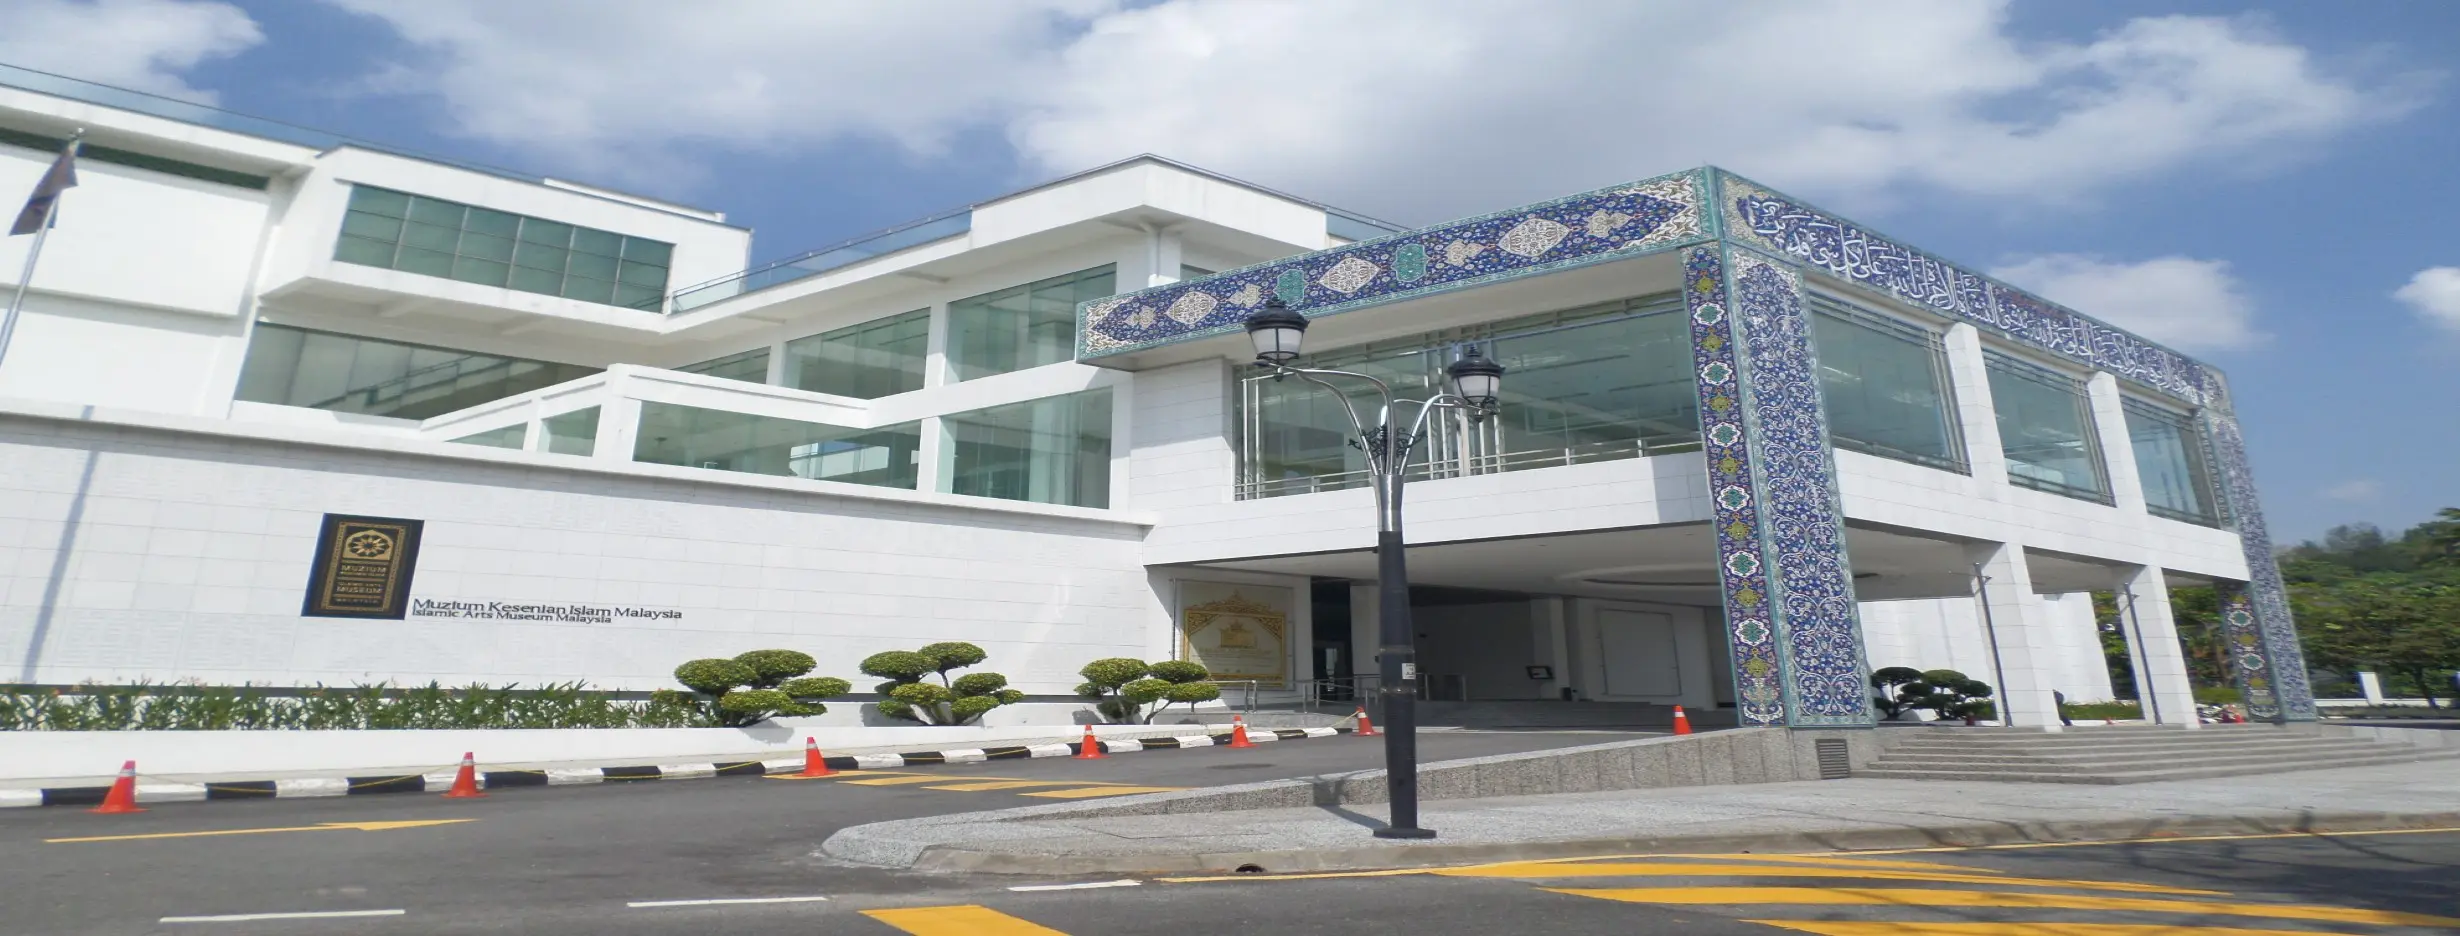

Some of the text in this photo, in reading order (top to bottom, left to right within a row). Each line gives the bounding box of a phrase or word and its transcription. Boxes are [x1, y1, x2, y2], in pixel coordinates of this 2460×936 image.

[412, 607, 612, 624] Islamic Arts Museum Malaysia
[413, 598, 683, 620] Muzium Kesenian Islam Malaysia
